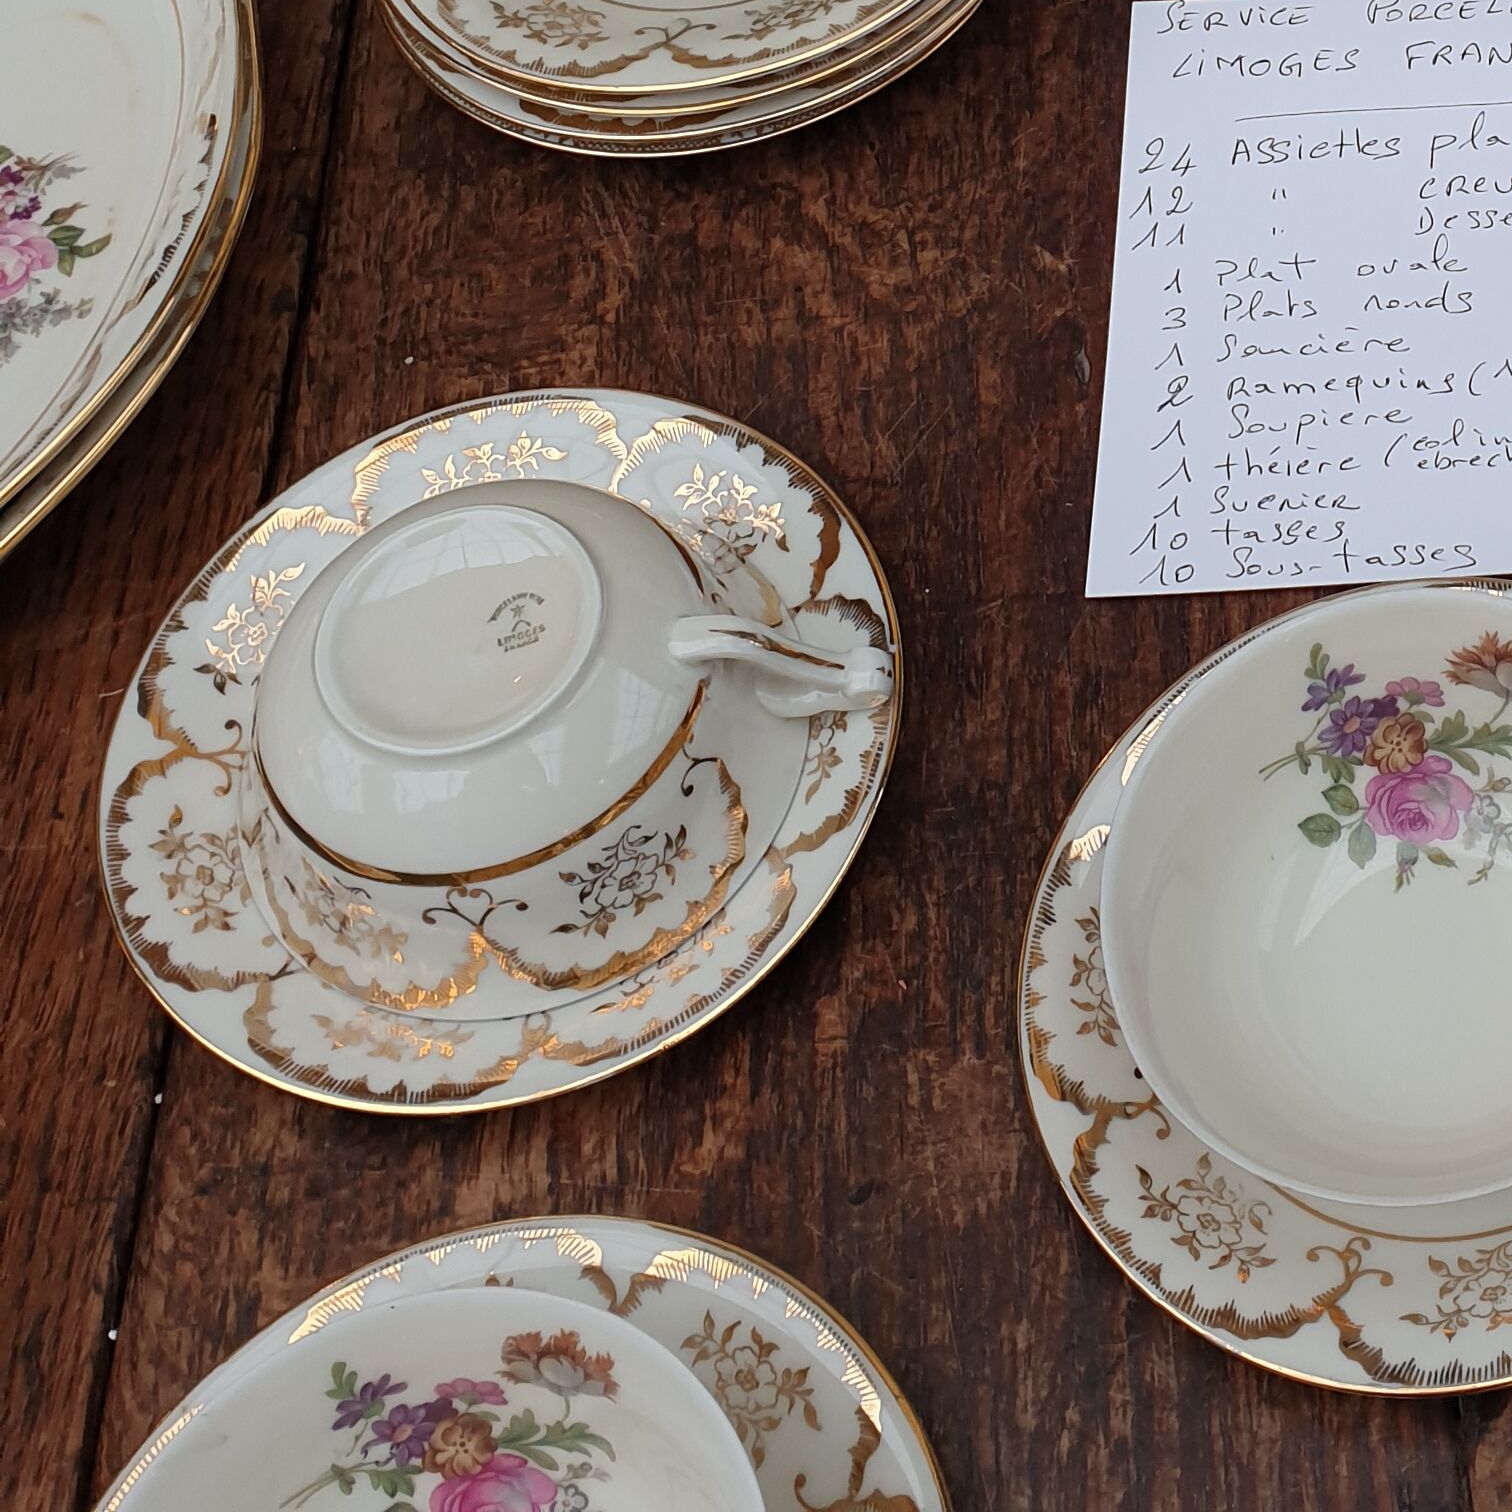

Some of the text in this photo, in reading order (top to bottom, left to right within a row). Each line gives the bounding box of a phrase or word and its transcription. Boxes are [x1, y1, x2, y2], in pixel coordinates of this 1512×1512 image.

[1157, 0, 1315, 34] SERVICE
[1172, 48, 1360, 78] LIMOGES
[1138, 137, 1198, 177] 24
[1129, 186, 1193, 219] 12
[1131, 221, 1185, 251] 11
[1164, 233, 1468, 294] 1 Plat ovale
[1163, 307, 1187, 330] 3
[1223, 289, 1318, 322] Plats
[1154, 342, 1184, 371] 1
[1157, 375, 1194, 413] 2
[1226, 368, 1456, 404] Ramequins
[1150, 419, 1186, 451] 1
[1156, 456, 1192, 489] 1
[1153, 495, 1181, 519] 1
[1129, 518, 1346, 556] 10 tasses
[1138, 554, 1195, 587] 10
